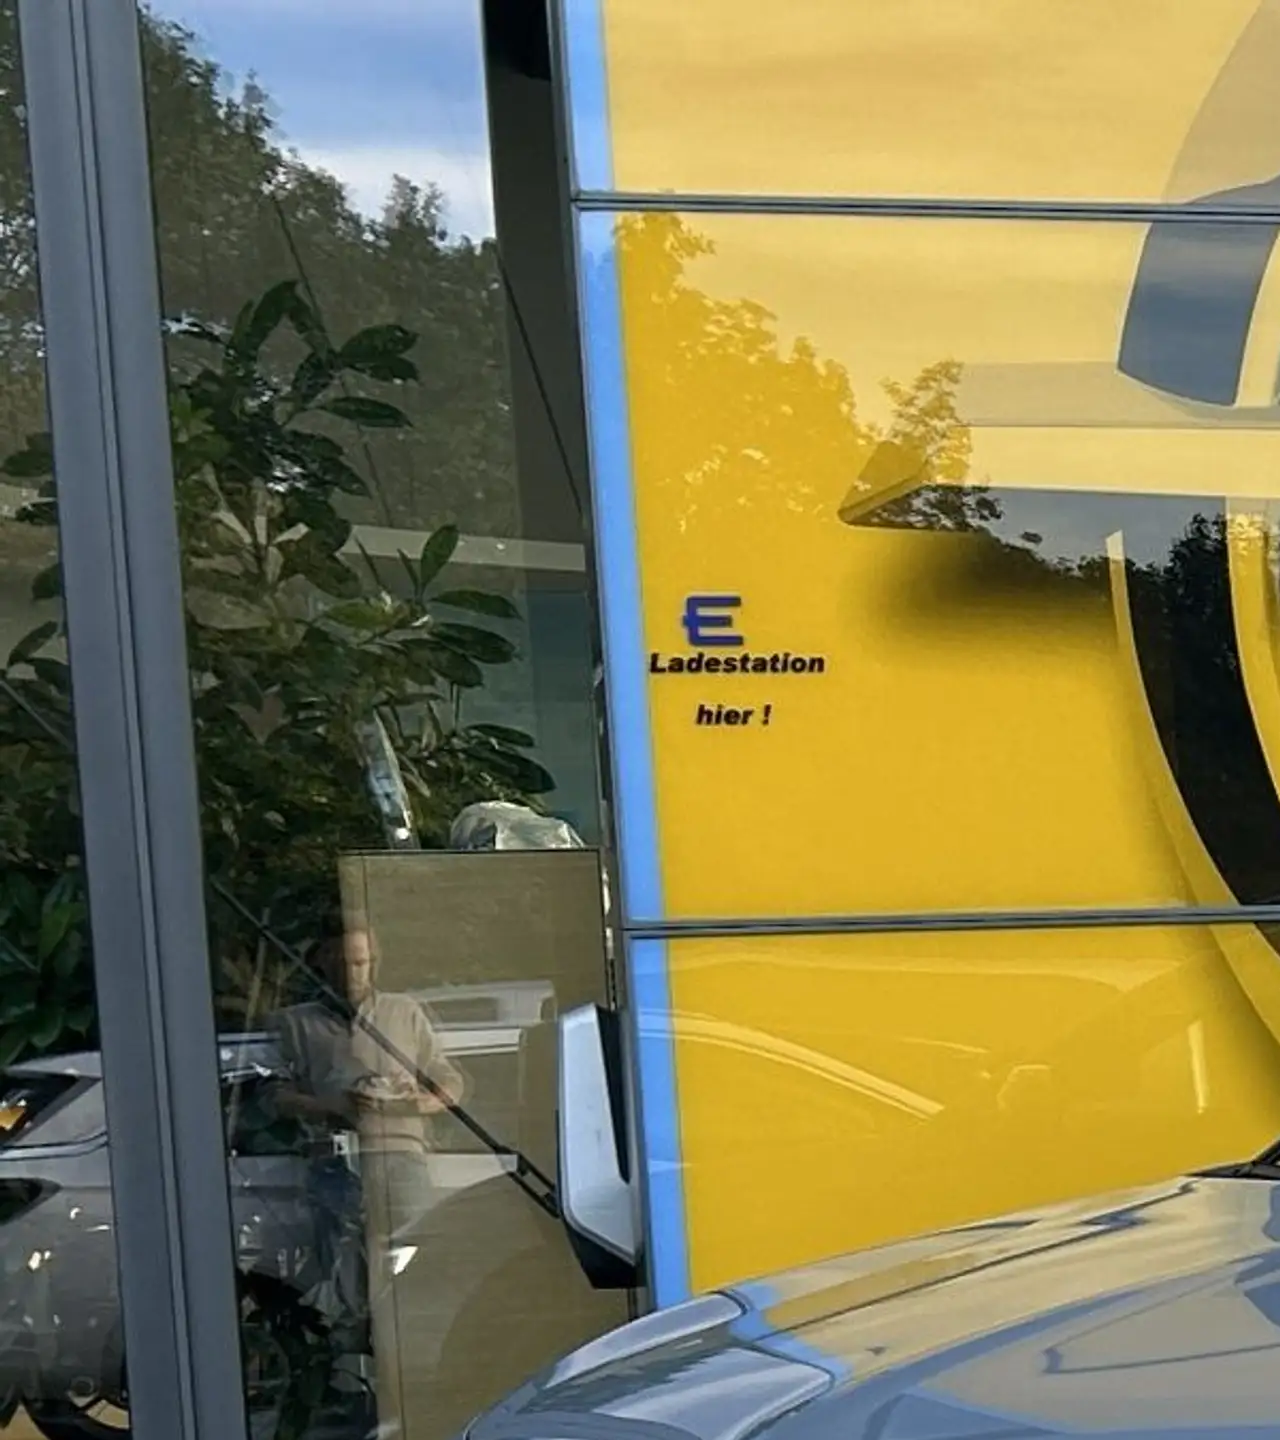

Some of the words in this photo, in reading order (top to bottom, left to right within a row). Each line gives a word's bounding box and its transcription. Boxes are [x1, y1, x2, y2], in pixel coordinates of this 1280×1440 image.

[649, 652, 825, 674] Ladestation
[695, 703, 754, 726] hier
[762, 703, 772, 726] !
